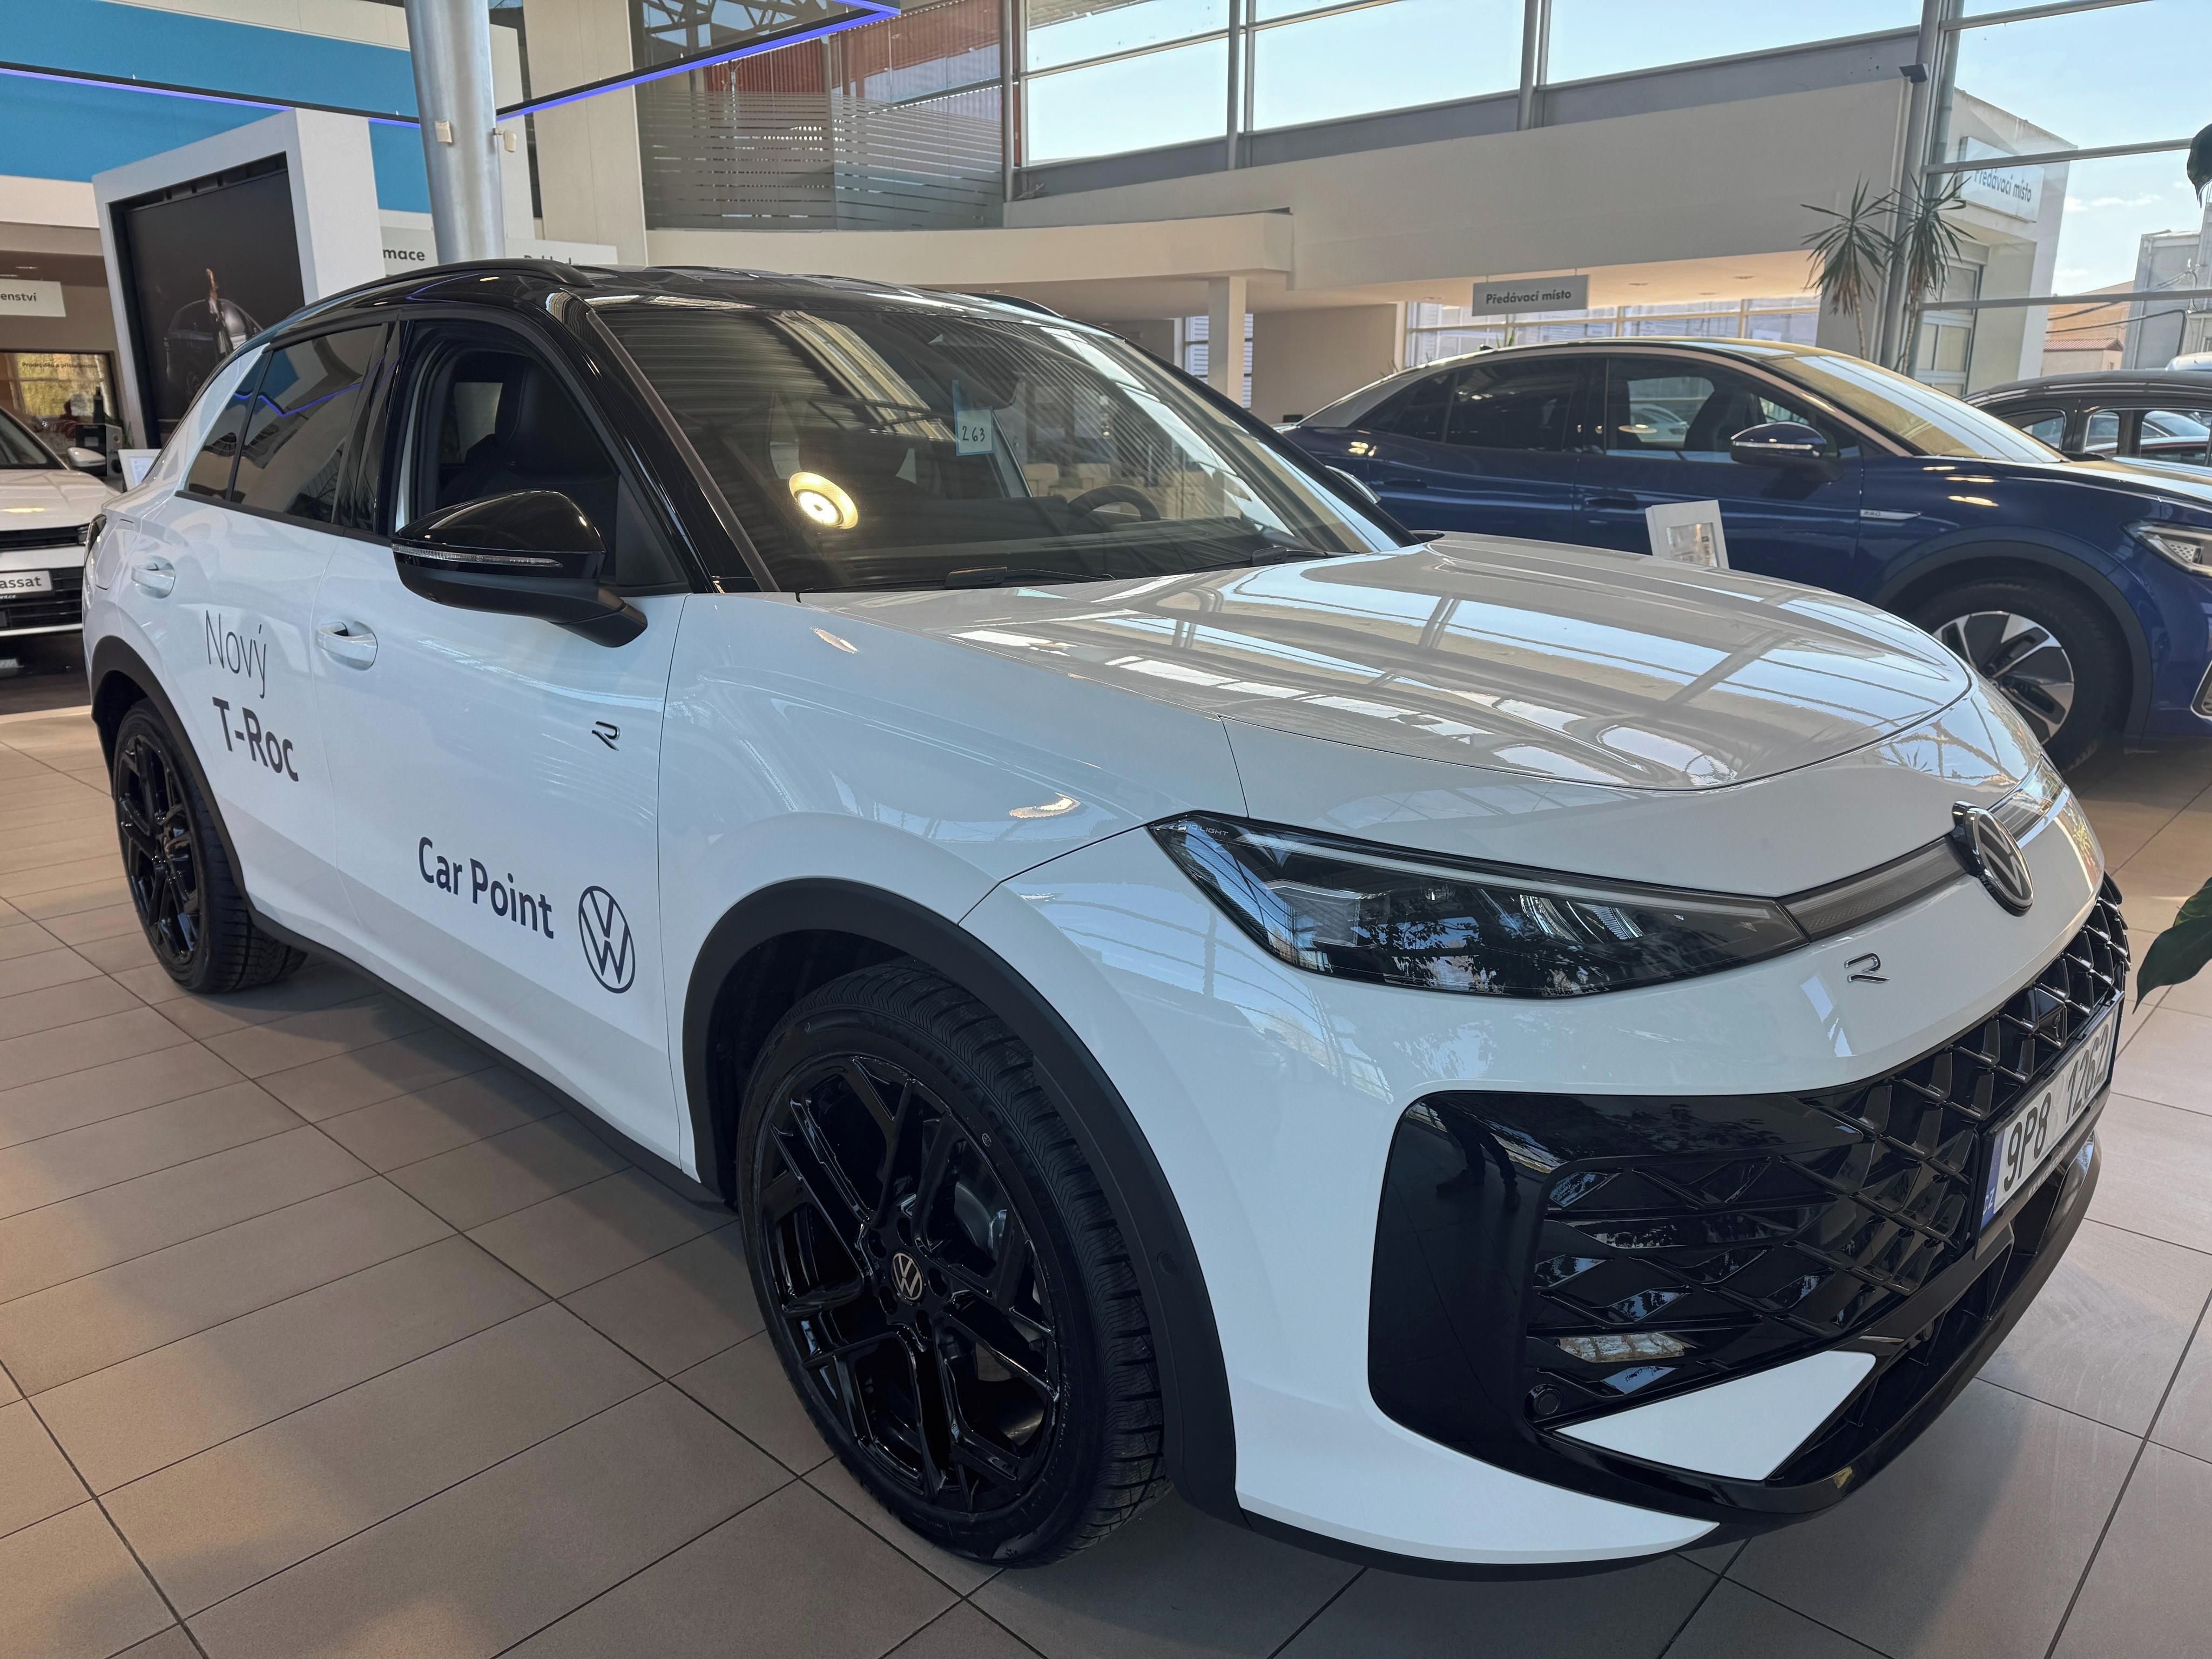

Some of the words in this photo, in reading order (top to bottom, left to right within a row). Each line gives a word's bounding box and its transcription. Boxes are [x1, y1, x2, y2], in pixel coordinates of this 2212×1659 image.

[2012, 179, 2032, 203] místo
[383, 249, 425, 261] mace
[1, 292, 37, 302] enství
[1486, 290, 1539, 304] Předávací
[1542, 289, 1571, 301] místo
[962, 425, 985, 442] 263
[206, 609, 267, 699] Nový
[212, 696, 299, 782] T-Roc
[419, 837, 463, 896] Car
[470, 858, 554, 940] Point
[2004, 1091, 2052, 1192] 9P8
[2066, 1024, 2109, 1124] 1262
